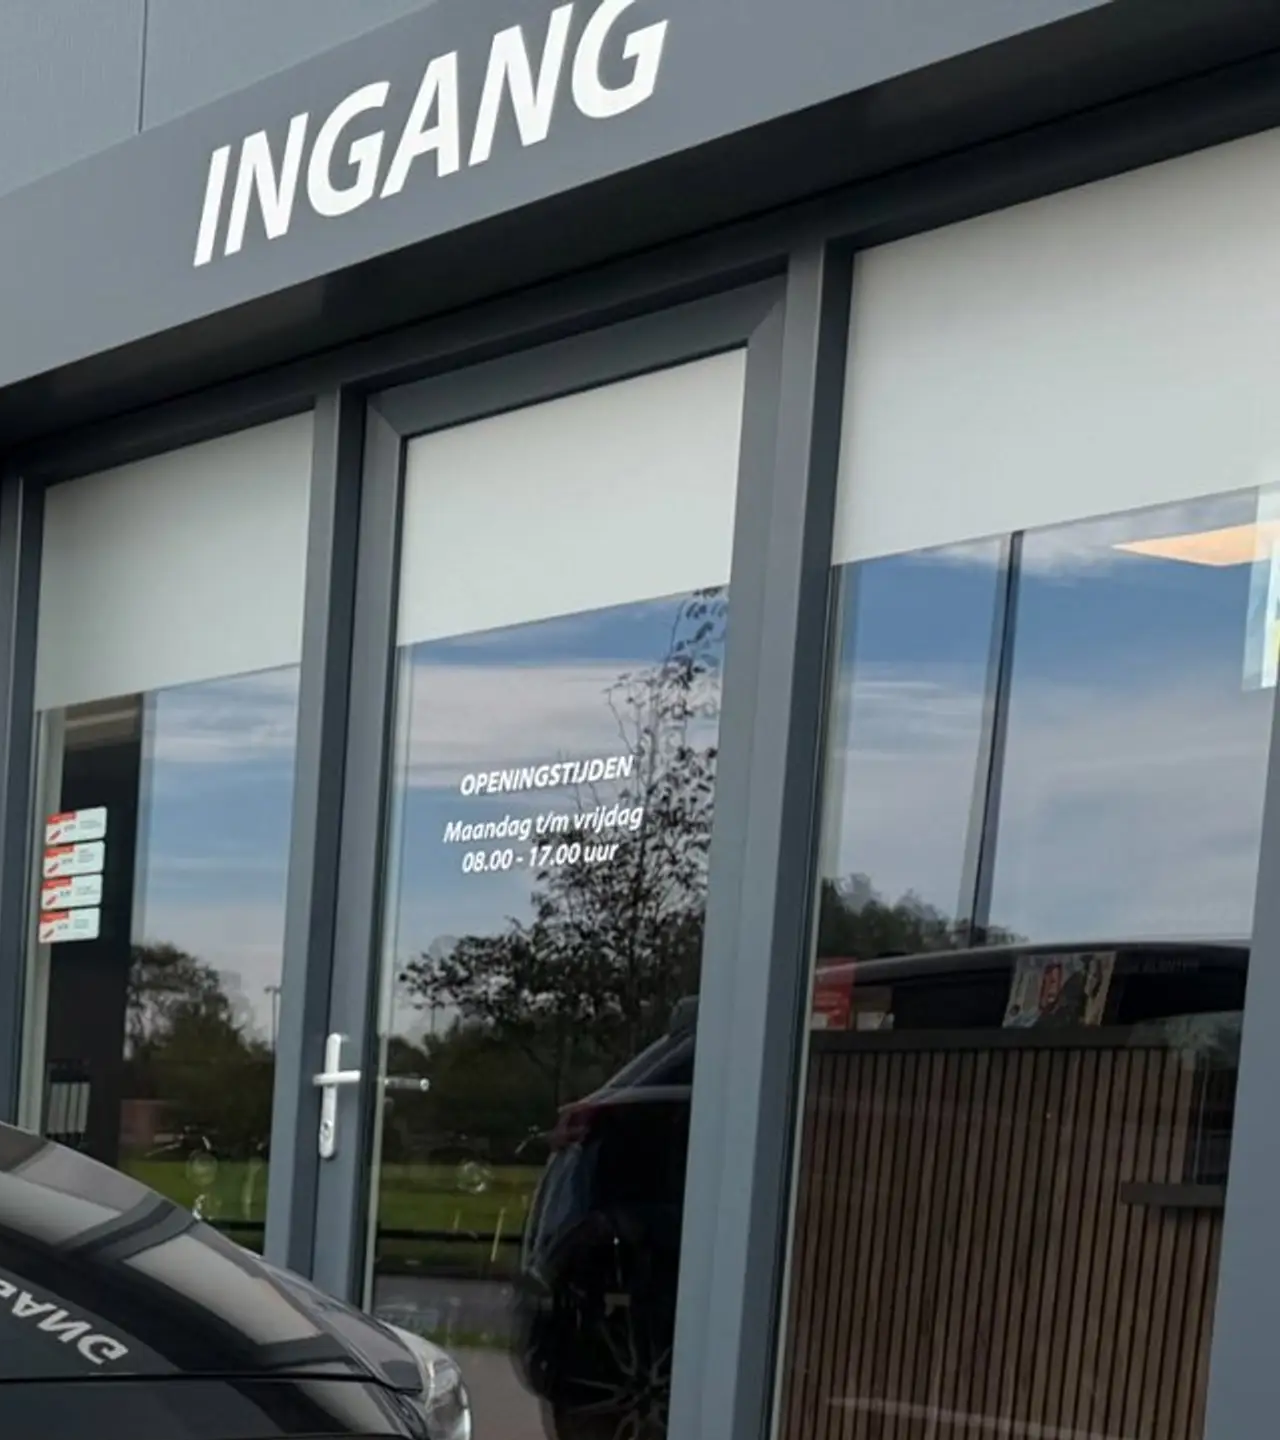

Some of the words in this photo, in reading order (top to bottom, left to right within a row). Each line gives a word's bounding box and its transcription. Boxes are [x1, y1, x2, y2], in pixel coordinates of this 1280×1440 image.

[194, 0, 668, 267] INGANG
[460, 755, 633, 795] OPENINGSTIJDEN
[443, 815, 532, 843] Maandag
[536, 811, 568, 834] t/m
[573, 805, 644, 833] vrijdag
[462, 849, 513, 873] 08.00
[529, 843, 580, 866] 17.00
[584, 844, 618, 861] uur
